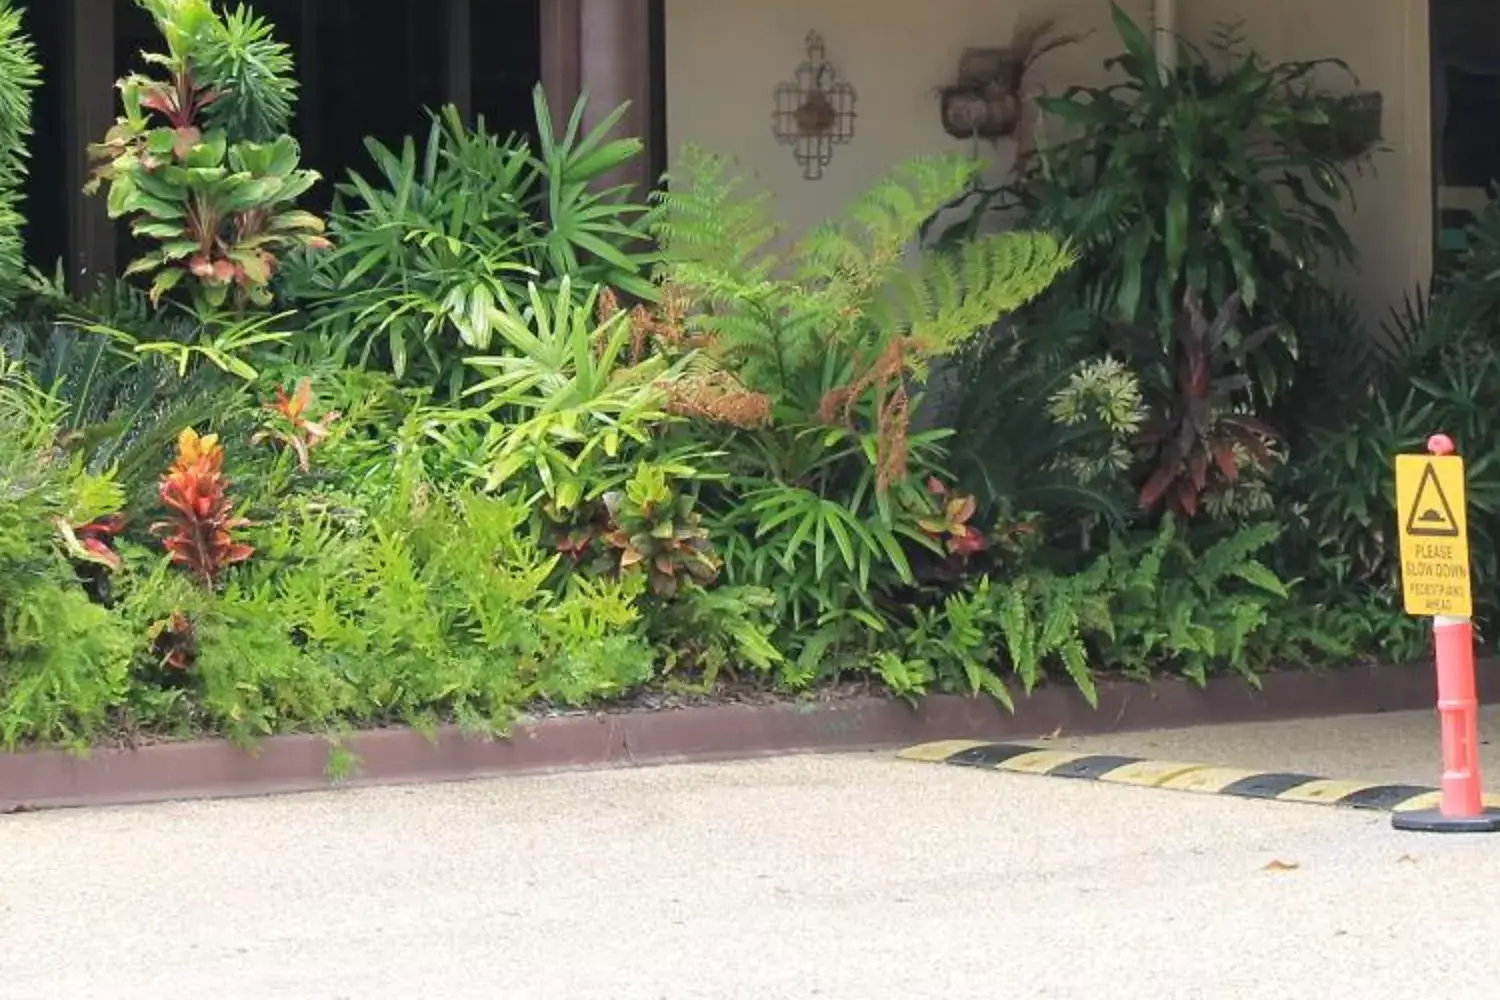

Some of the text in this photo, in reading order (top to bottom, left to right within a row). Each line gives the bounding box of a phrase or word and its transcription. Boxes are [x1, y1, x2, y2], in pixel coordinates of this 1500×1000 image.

[1415, 543, 1453, 560] PLEASE
[1405, 560, 1467, 578] SLOW DOWN
